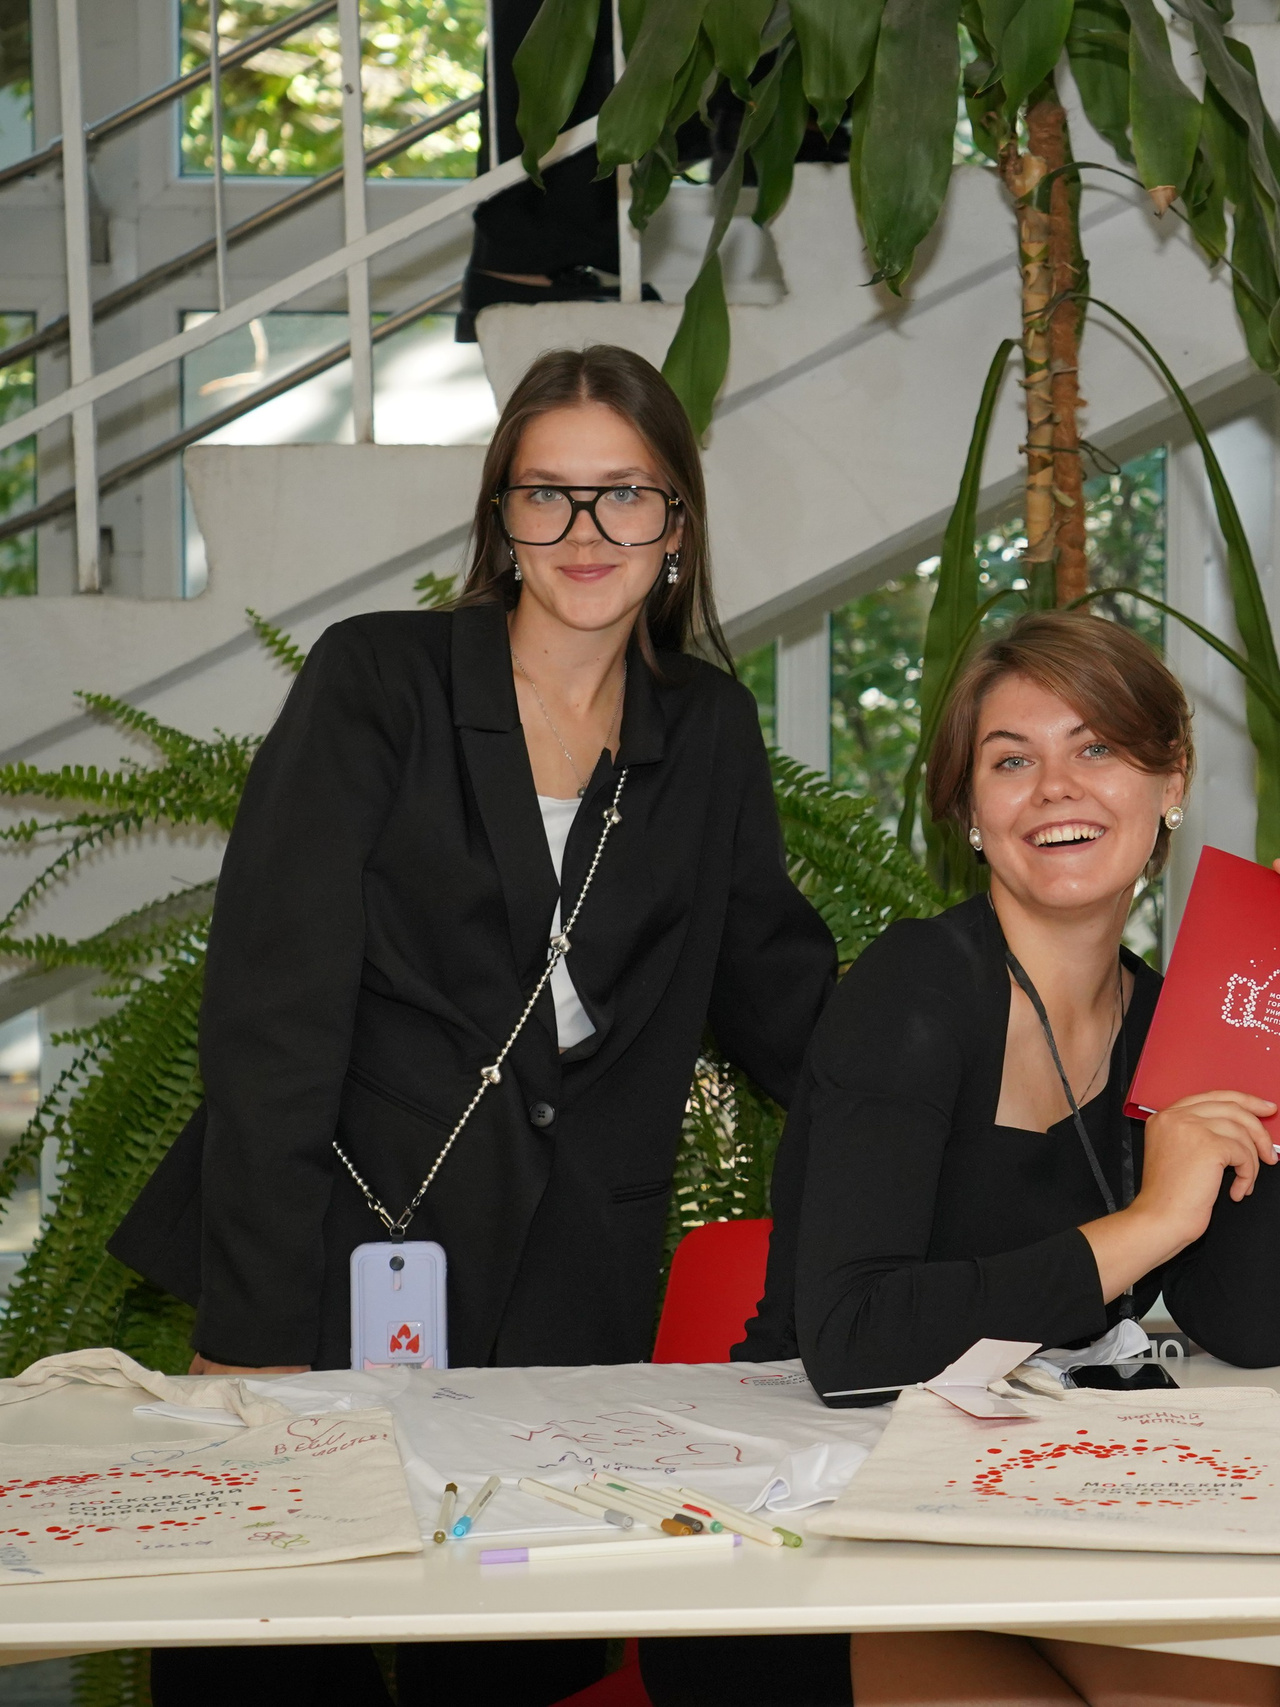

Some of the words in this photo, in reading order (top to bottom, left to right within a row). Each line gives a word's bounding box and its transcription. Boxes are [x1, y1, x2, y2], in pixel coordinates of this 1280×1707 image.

[69, 1487, 243, 1506] МОСКОВСКИЙ
[69, 1496, 220, 1511] ГОРОДСКОЙ
[68, 1501, 244, 1517] УНИВЕРСИТЕТ
